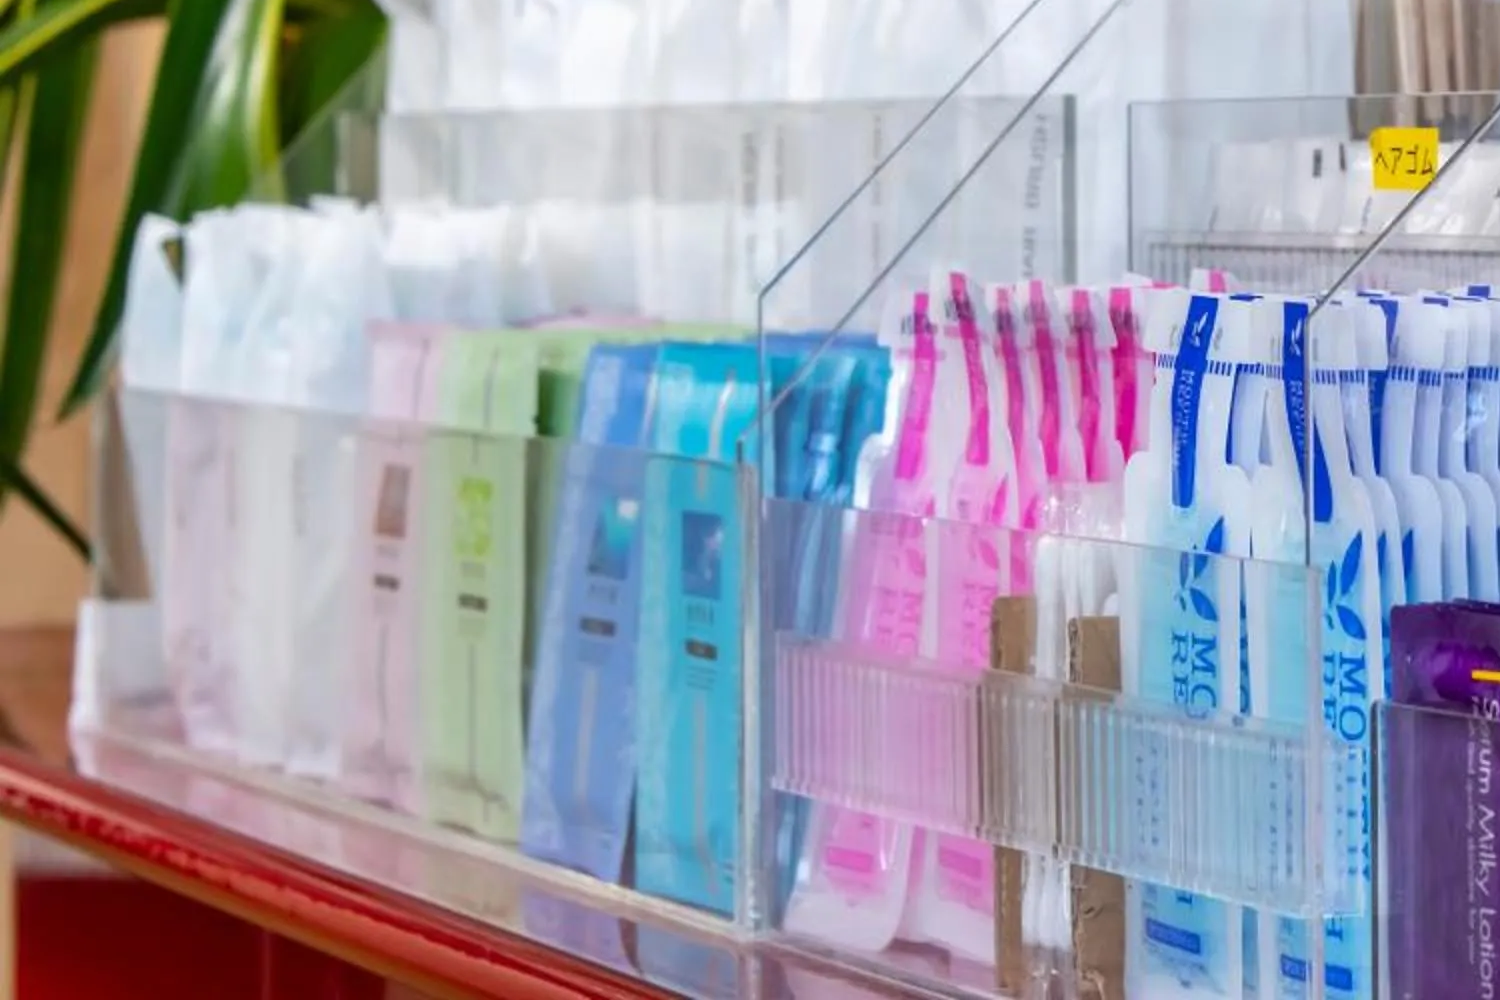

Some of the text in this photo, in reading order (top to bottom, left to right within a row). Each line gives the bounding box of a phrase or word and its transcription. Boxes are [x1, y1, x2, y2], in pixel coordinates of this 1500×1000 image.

[1375, 144, 1434, 176] ヘアゴム
[1474, 698, 1500, 1000] Serum Milky Lotion
